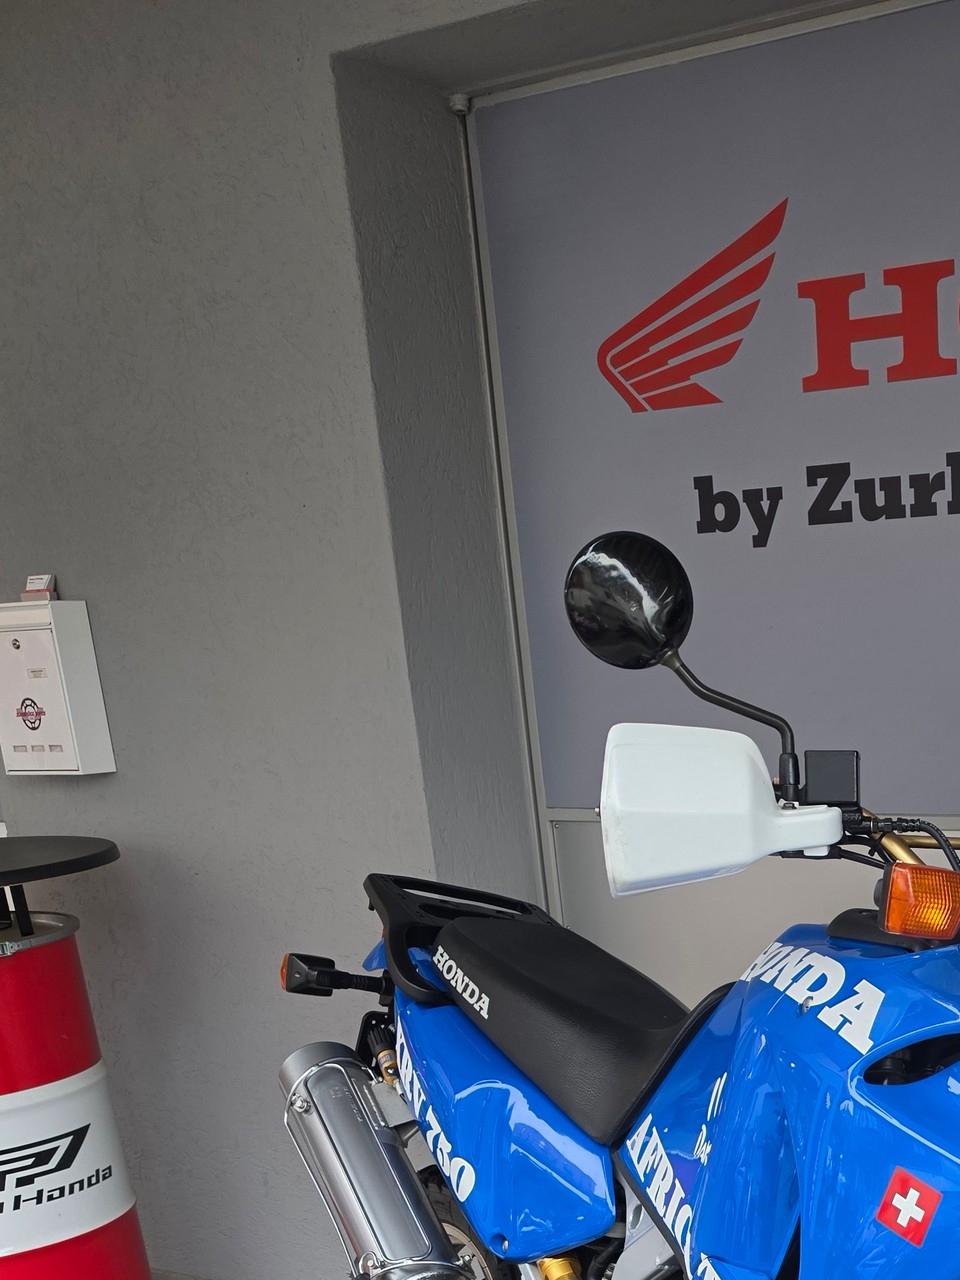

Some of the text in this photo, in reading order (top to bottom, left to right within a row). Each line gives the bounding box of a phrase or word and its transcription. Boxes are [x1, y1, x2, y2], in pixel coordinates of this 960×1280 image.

[692, 474, 784, 549] by
[432, 945, 490, 1020] HONDA
[12, 1164, 113, 1211] Honda
[426, 1104, 476, 1203] 750
